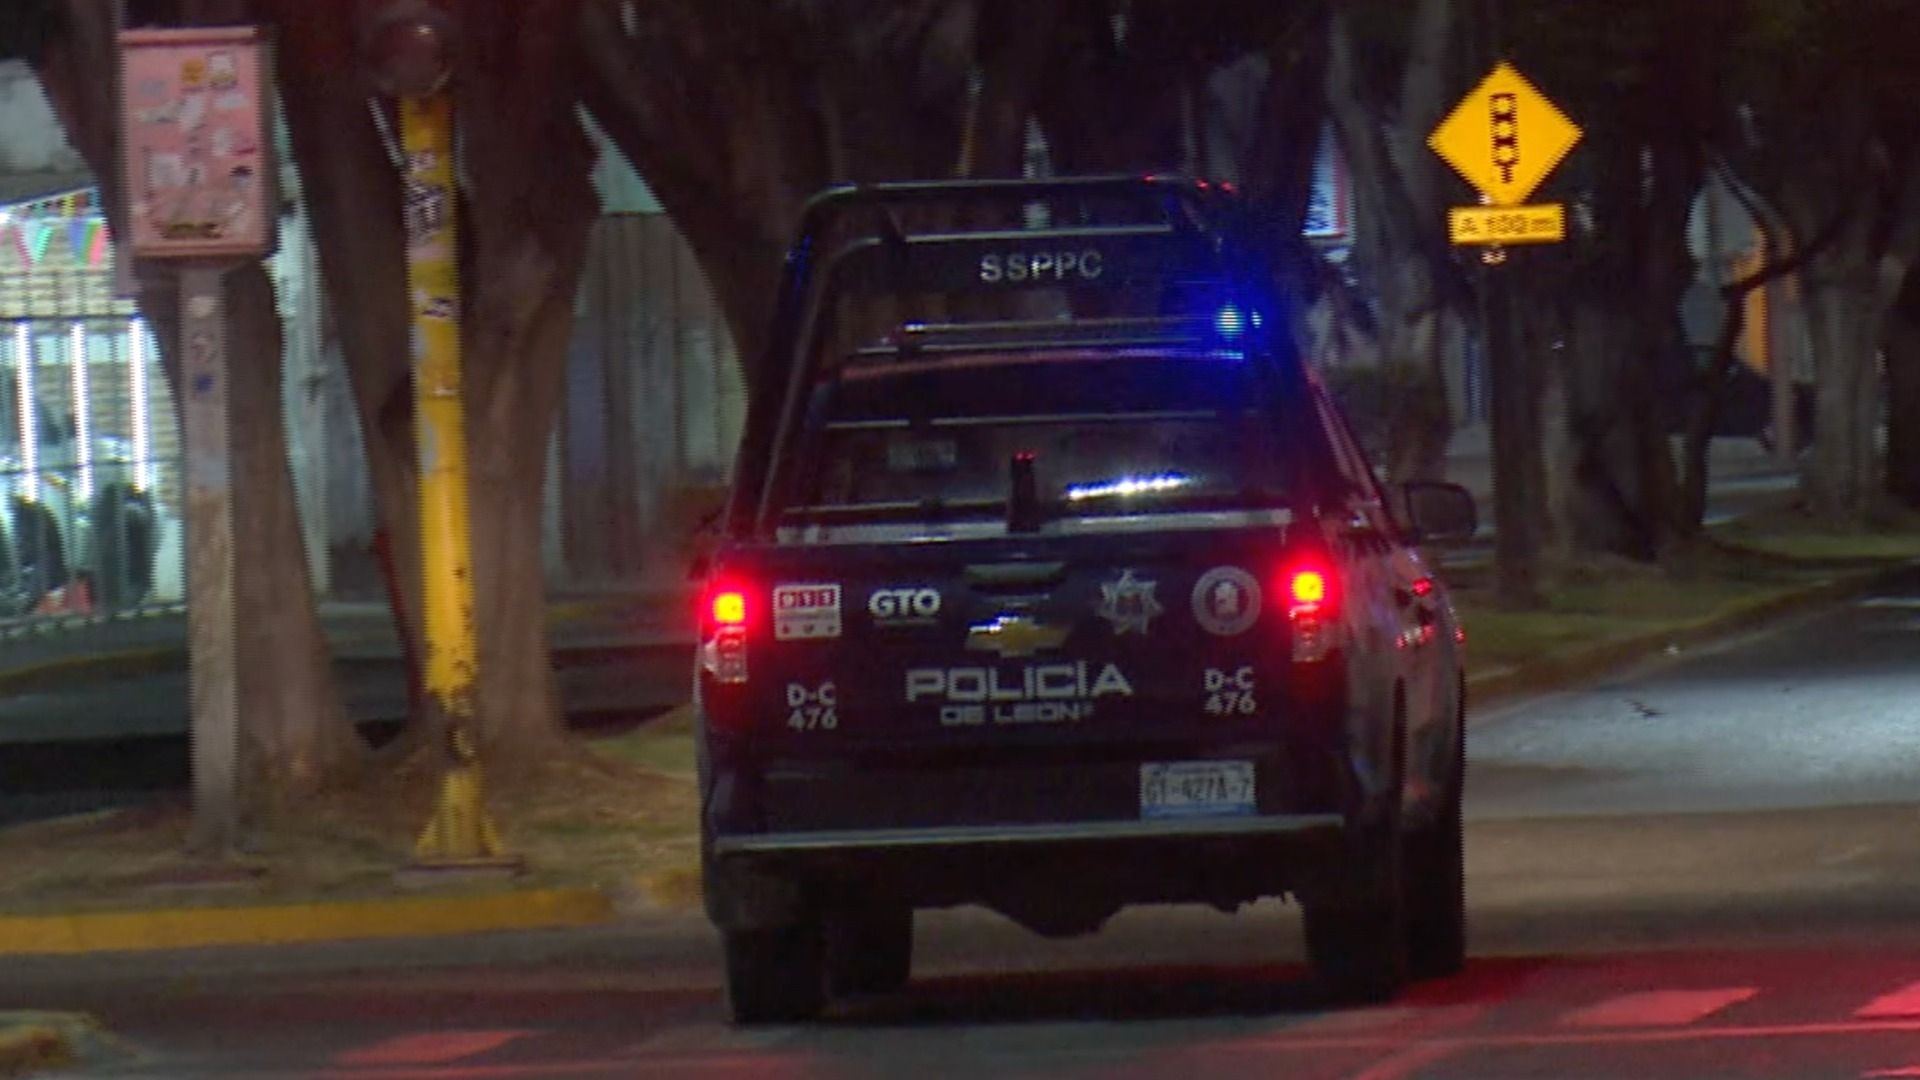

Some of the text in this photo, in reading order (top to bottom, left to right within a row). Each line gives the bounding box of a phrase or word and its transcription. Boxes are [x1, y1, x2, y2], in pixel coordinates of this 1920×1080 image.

[1486, 214, 1528, 235] 100
[980, 249, 1104, 282] SSPPC
[868, 589, 941, 617] GTO
[1205, 666, 1254, 691] D-C
[787, 682, 836, 707] D-C
[1205, 691, 1256, 716] 476
[787, 707, 838, 731] 476
[940, 705, 985, 725] DE
